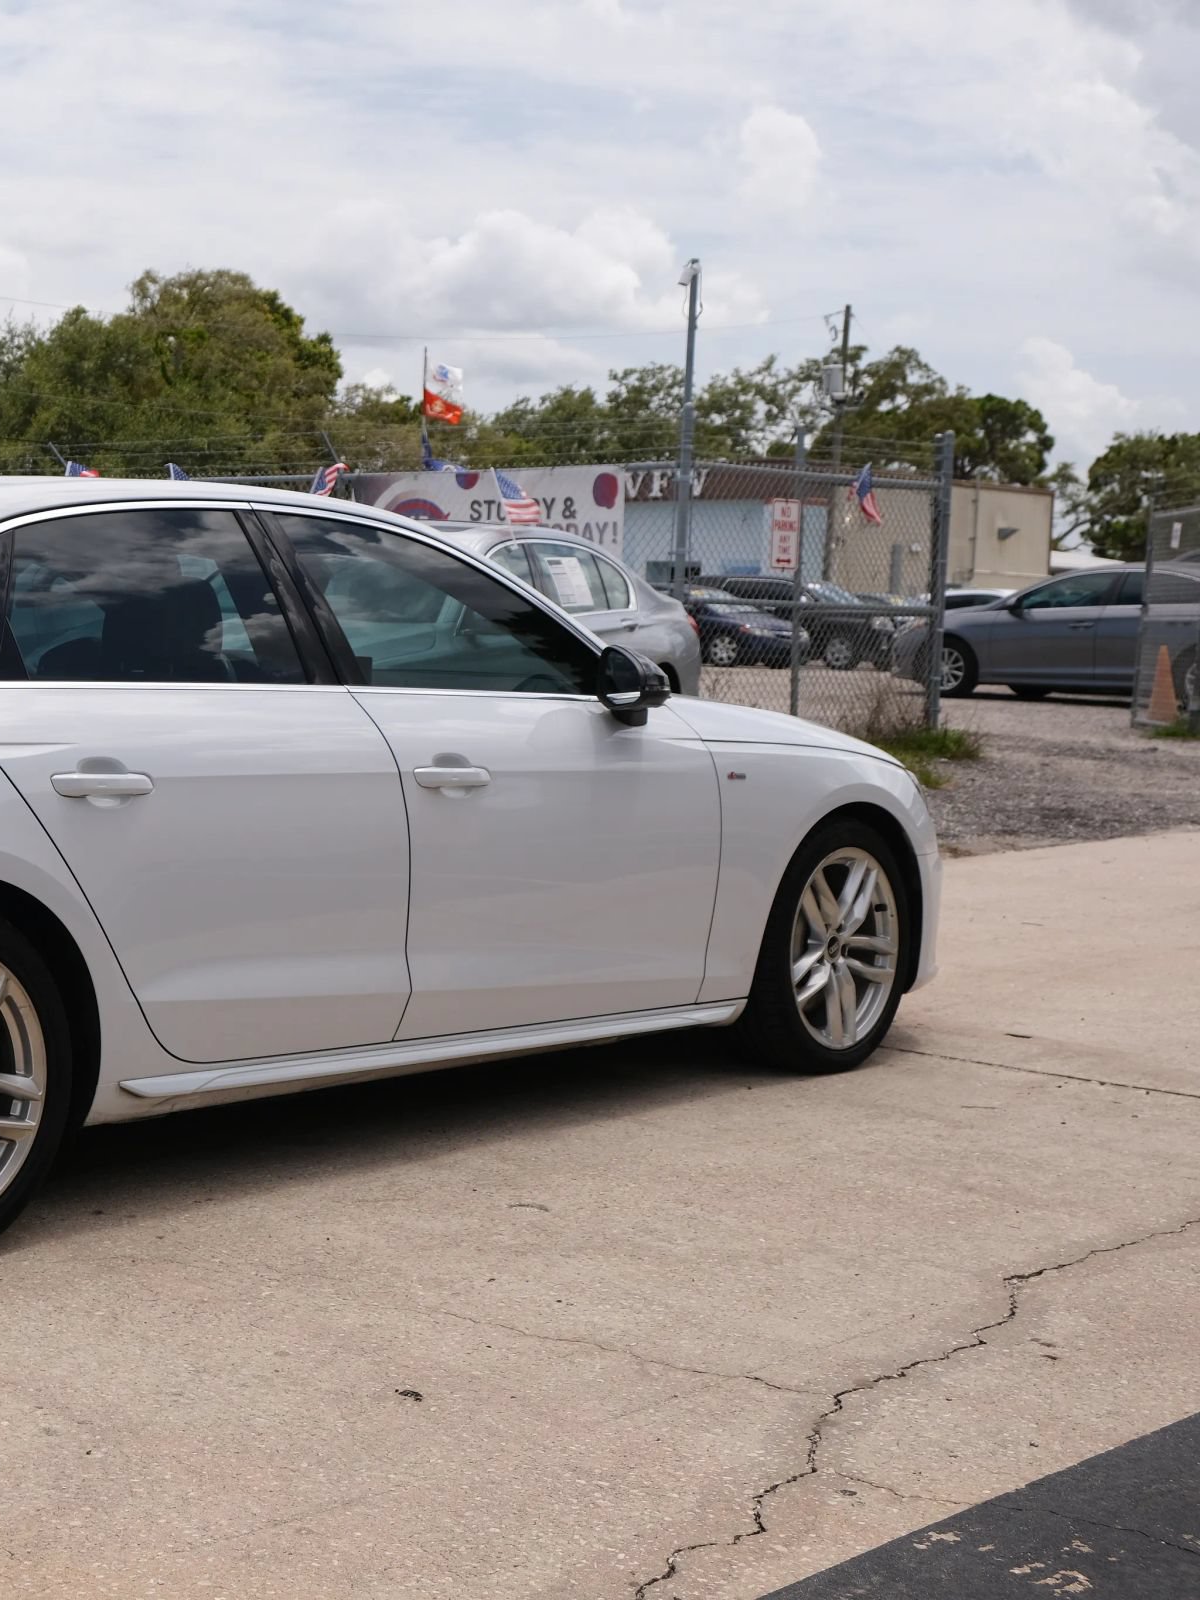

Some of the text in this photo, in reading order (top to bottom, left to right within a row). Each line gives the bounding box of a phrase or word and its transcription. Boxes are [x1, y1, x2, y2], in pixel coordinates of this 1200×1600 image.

[562, 496, 577, 519] &
[781, 507, 791, 517] NO
[774, 520, 798, 531] PARKING
[779, 535, 791, 543] ANY
[778, 545, 791, 554] TIME
